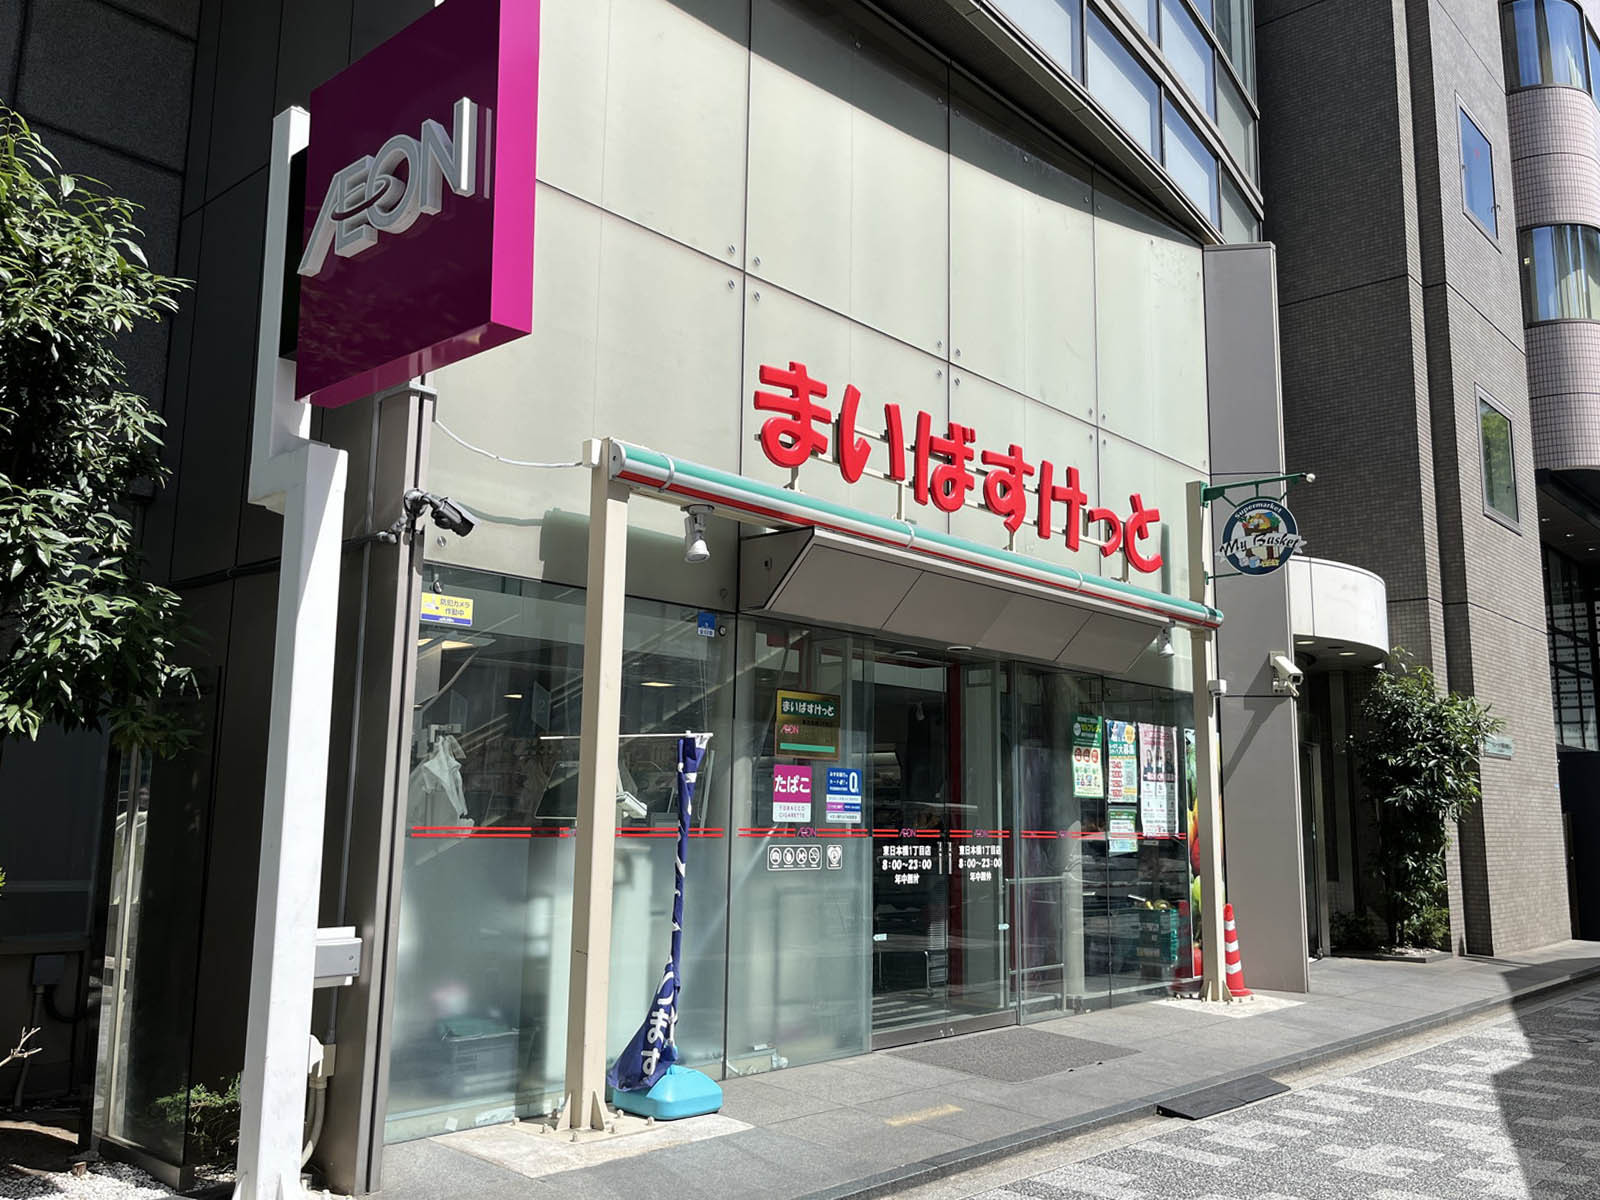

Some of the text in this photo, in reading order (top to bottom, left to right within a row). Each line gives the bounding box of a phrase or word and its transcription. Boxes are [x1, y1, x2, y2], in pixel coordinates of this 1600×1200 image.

[297, 97, 478, 277] AEON
[754, 361, 1163, 573] まいばすけっと
[1234, 502, 1282, 519] Supermarket
[1219, 531, 1299, 556] My Basket
[782, 700, 835, 716] まいばすけっと
[774, 774, 810, 793] たばこ
